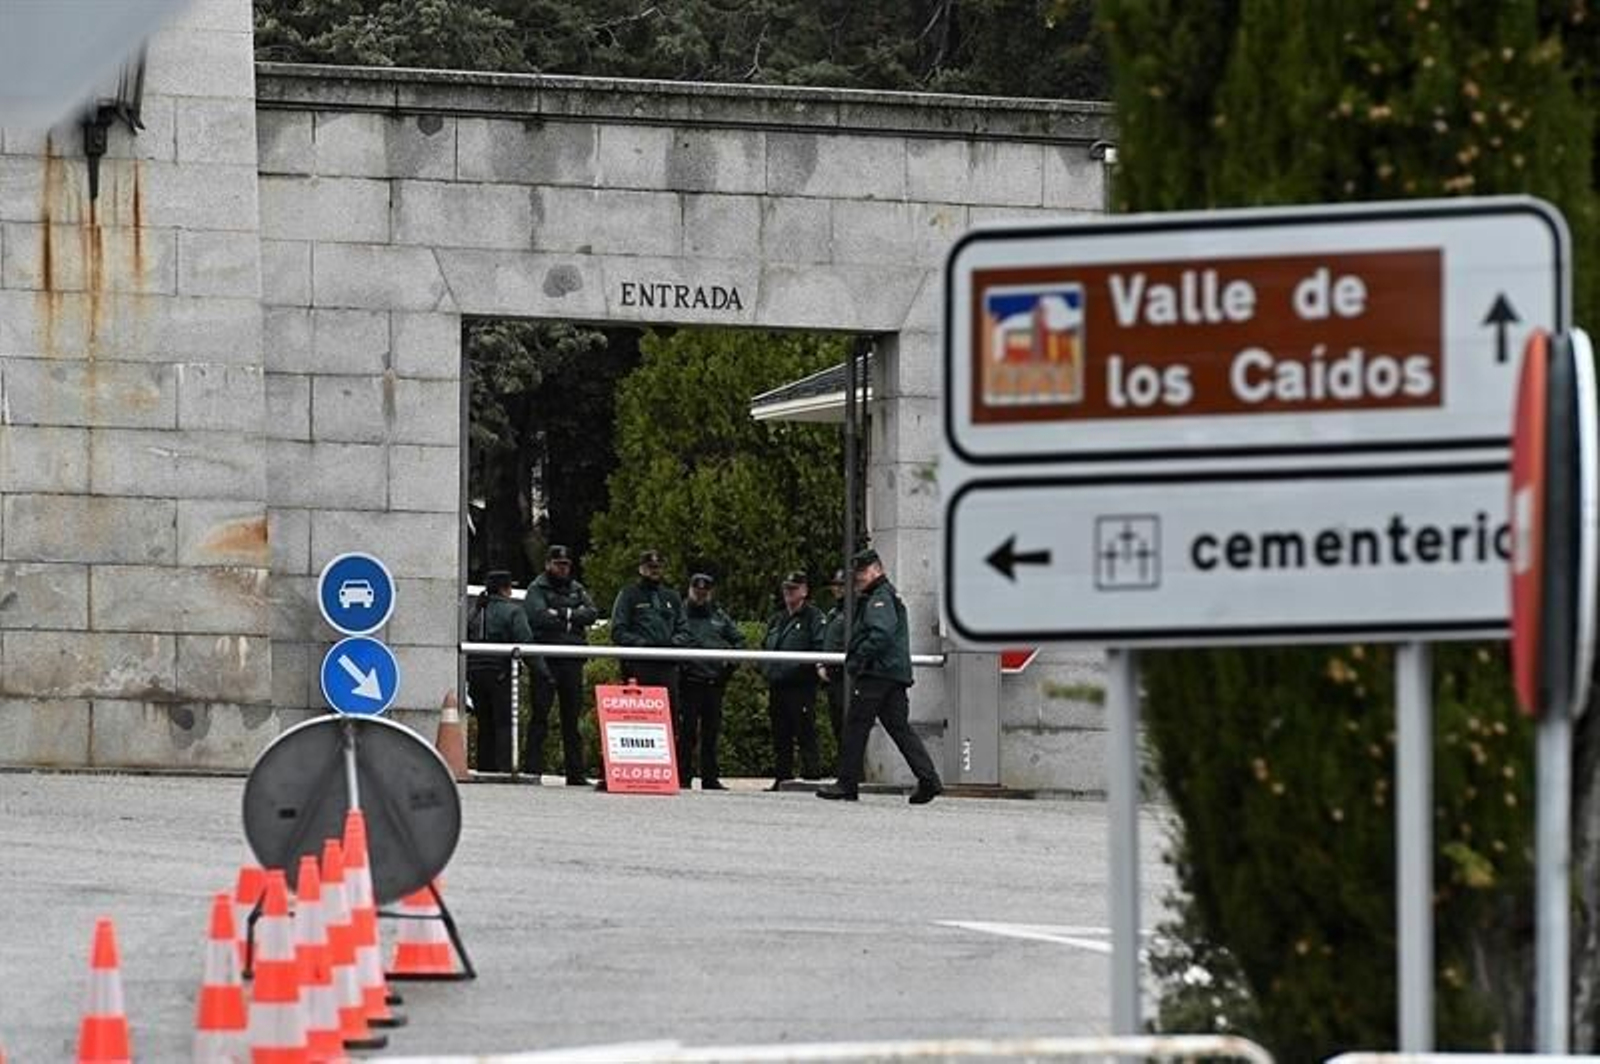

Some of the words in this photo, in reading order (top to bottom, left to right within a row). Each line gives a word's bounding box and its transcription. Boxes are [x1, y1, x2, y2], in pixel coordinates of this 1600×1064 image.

[620, 282, 744, 310] ENTRADA
[1108, 269, 1255, 326] Valle
[1293, 266, 1368, 320] de
[1107, 355, 1194, 408] los
[1230, 345, 1435, 404] Caídos
[602, 697, 664, 709] CERRADO
[611, 767, 672, 779] CLOSED
